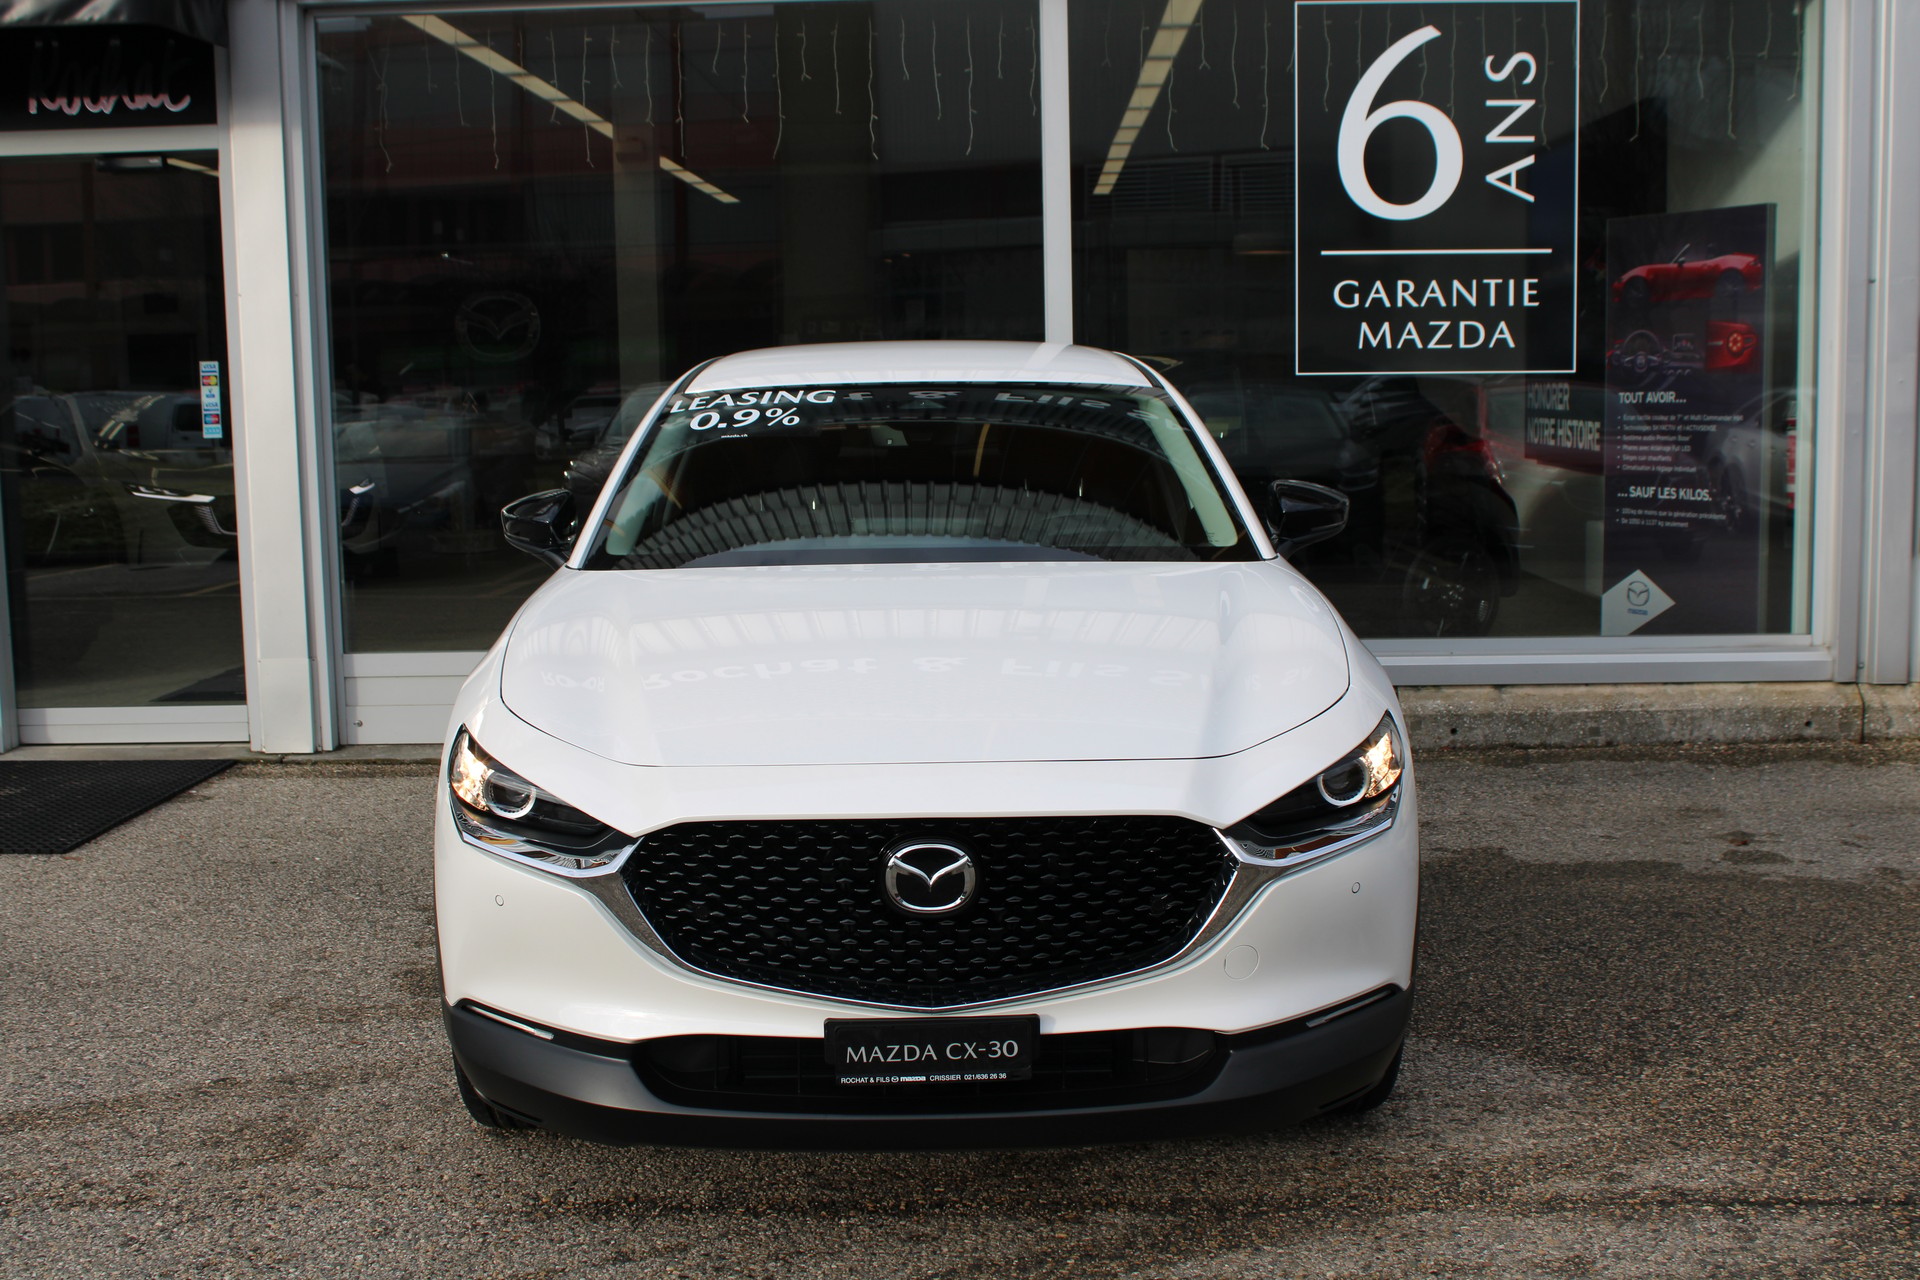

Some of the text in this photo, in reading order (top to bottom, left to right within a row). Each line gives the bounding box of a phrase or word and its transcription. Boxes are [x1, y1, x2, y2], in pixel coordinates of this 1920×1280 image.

[1337, 25, 1463, 220] 6
[1484, 51, 1537, 203] ANS
[1333, 278, 1540, 308] GARANTIE
[1358, 320, 1516, 349] MAZDA
[669, 389, 837, 414] LEASING
[1527, 382, 1570, 411] HONORER
[1618, 391, 1687, 404] TOUT AVOIR...
[689, 407, 800, 431] 0.9%
[1526, 416, 1601, 452] NOTRE HISTOIRE
[1657, 487, 1677, 500] LES
[1679, 488, 1712, 502] KILOS.
[846, 1040, 1019, 1064] MAZDA CX-30
[929, 1074, 961, 1082] CRISSIER
[964, 1073, 988, 1081] 021/636
